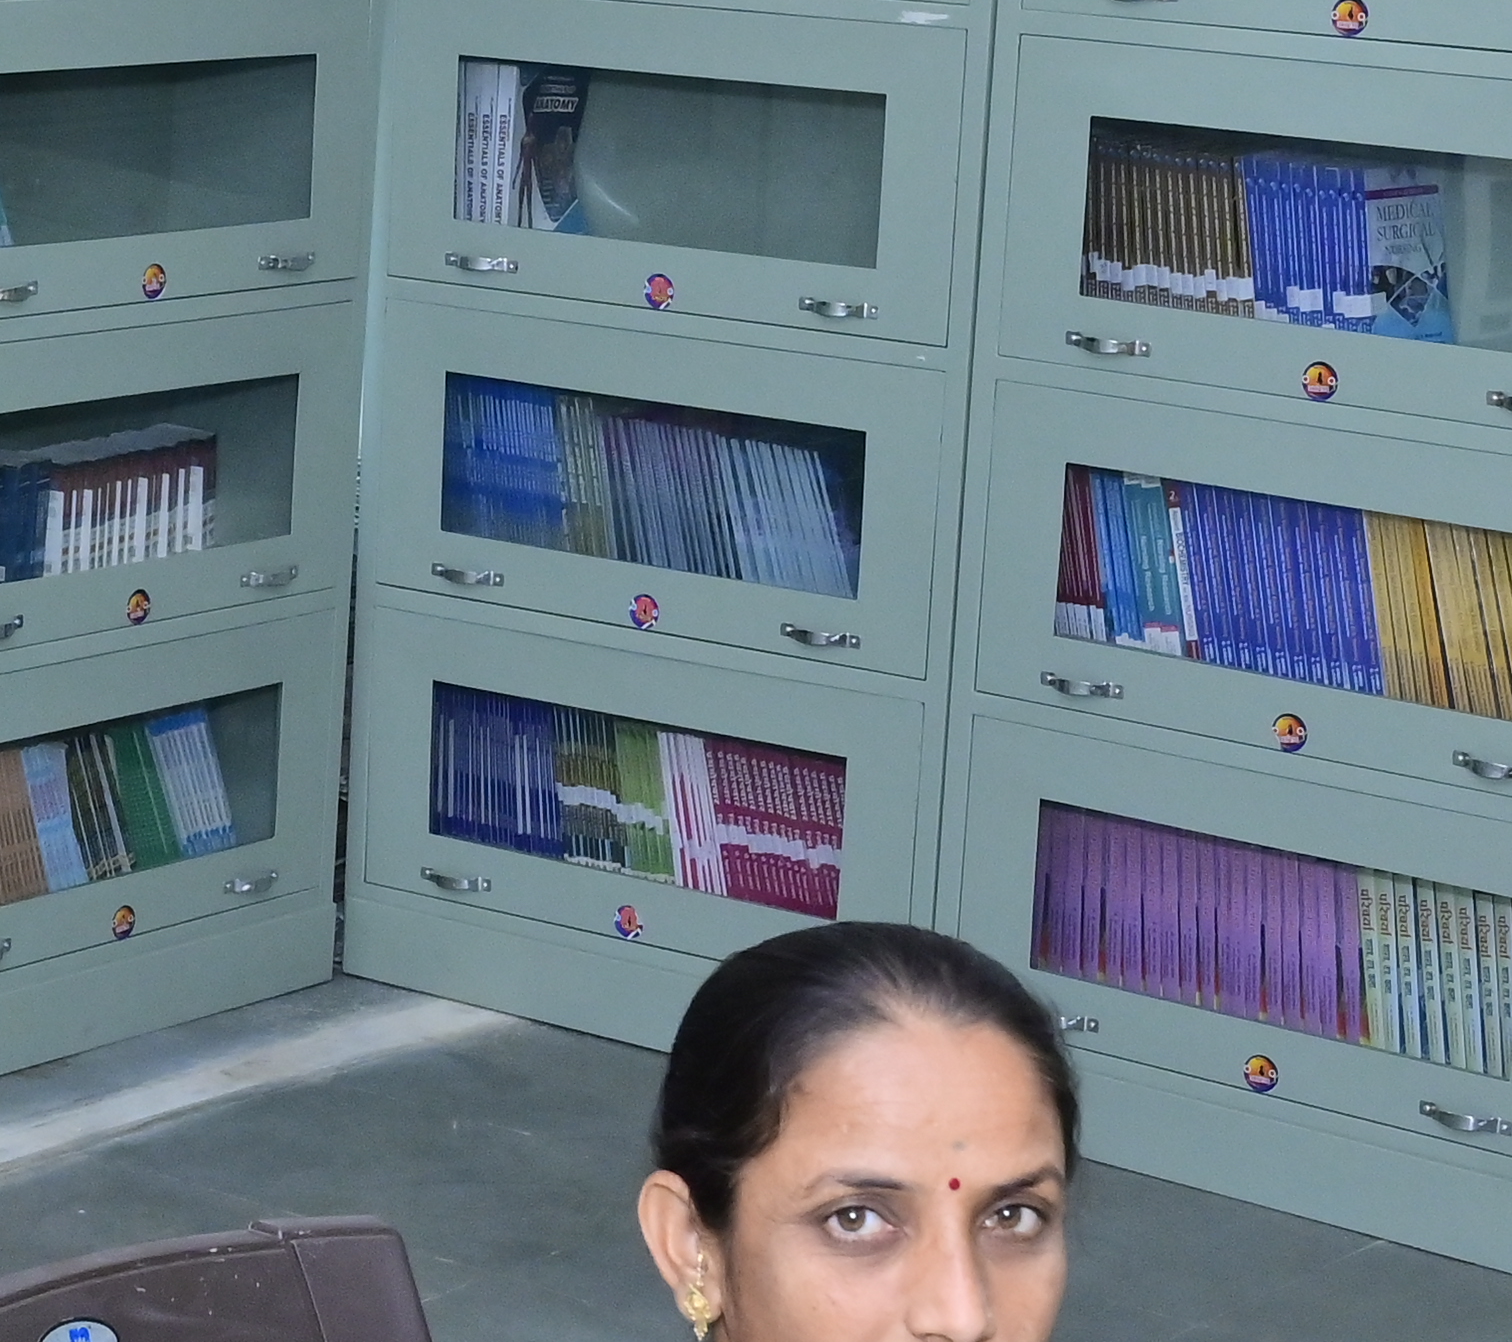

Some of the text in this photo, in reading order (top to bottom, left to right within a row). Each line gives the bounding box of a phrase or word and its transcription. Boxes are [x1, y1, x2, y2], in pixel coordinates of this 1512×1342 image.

[481, 114, 490, 166] ESSENTIALS
[496, 114, 507, 167] ESSENTIALS
[480, 169, 488, 180] OF
[496, 169, 504, 180] OF
[1140, 536, 1155, 611] Nursing Research
[1156, 540, 1172, 614] Nursing Research
[1176, 533, 1189, 585] BIOCHEMISTRY
